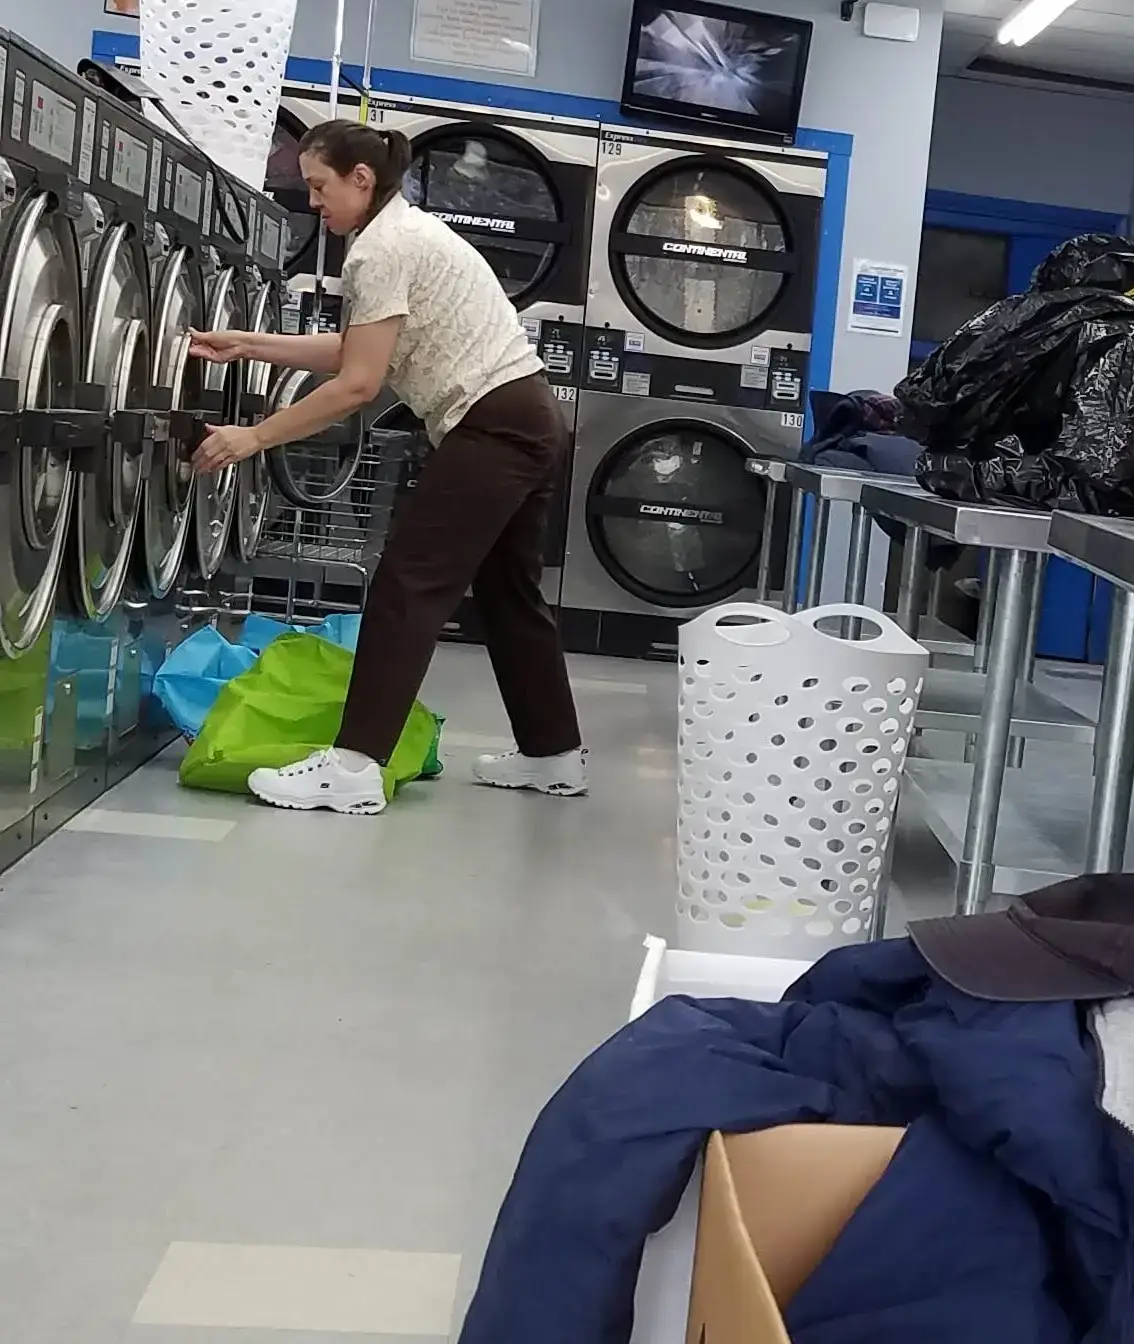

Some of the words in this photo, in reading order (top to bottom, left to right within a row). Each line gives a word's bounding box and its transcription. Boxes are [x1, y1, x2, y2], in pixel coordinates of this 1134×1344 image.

[369, 109, 385, 124] 31
[602, 141, 622, 156] 129
[662, 242, 748, 260] CONTINENTAL
[556, 387, 575, 401] 132
[783, 413, 803, 427] 130
